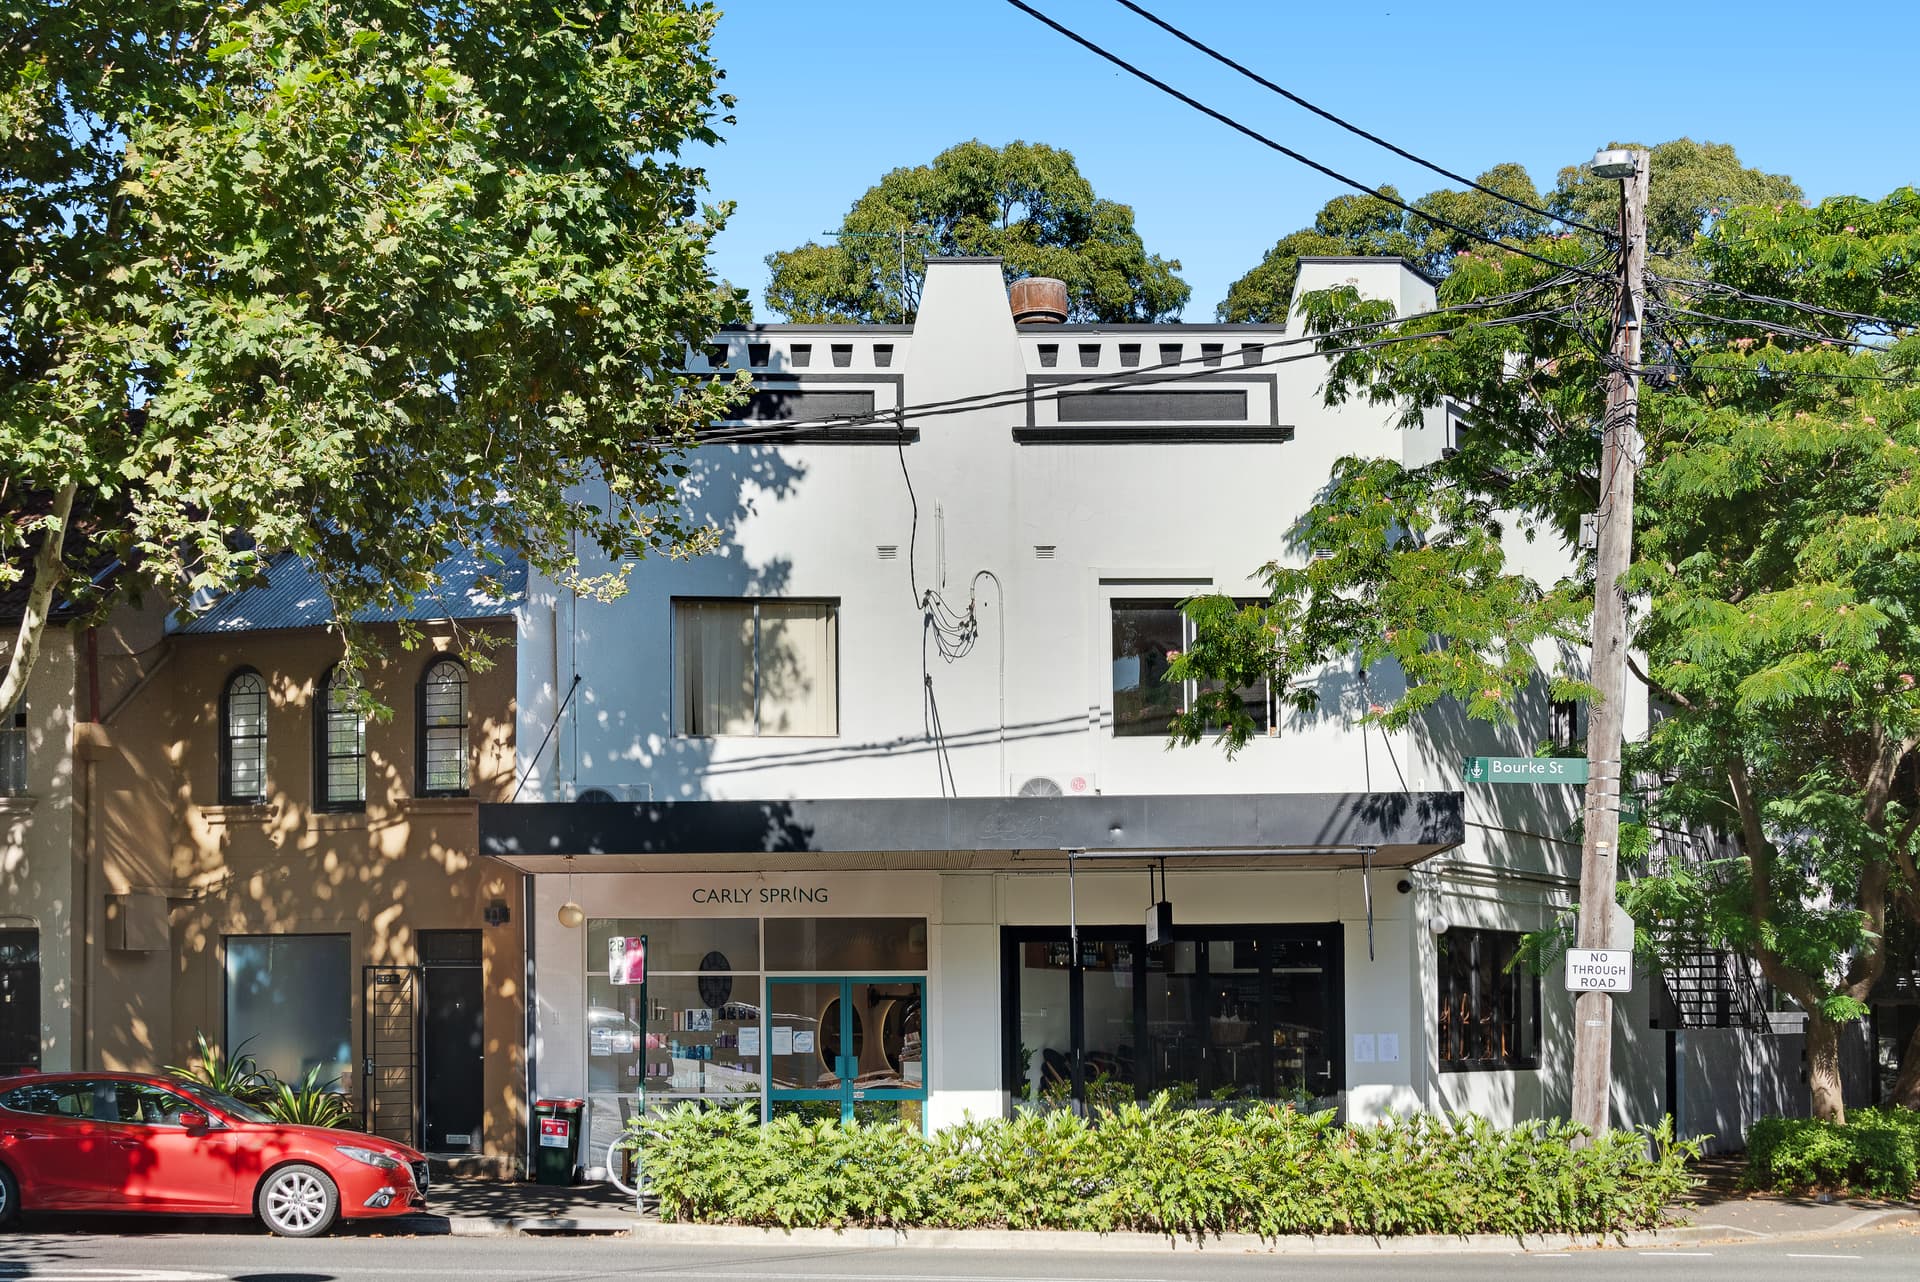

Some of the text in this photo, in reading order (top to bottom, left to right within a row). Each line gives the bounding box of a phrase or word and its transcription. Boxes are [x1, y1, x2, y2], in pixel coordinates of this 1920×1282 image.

[1493, 760, 1564, 774] Bourke St
[692, 885, 829, 904] CARLY SPRING
[1590, 952, 1608, 963] NO
[1572, 964, 1626, 976] THROUGH
[1580, 977, 1617, 988] ROAD
